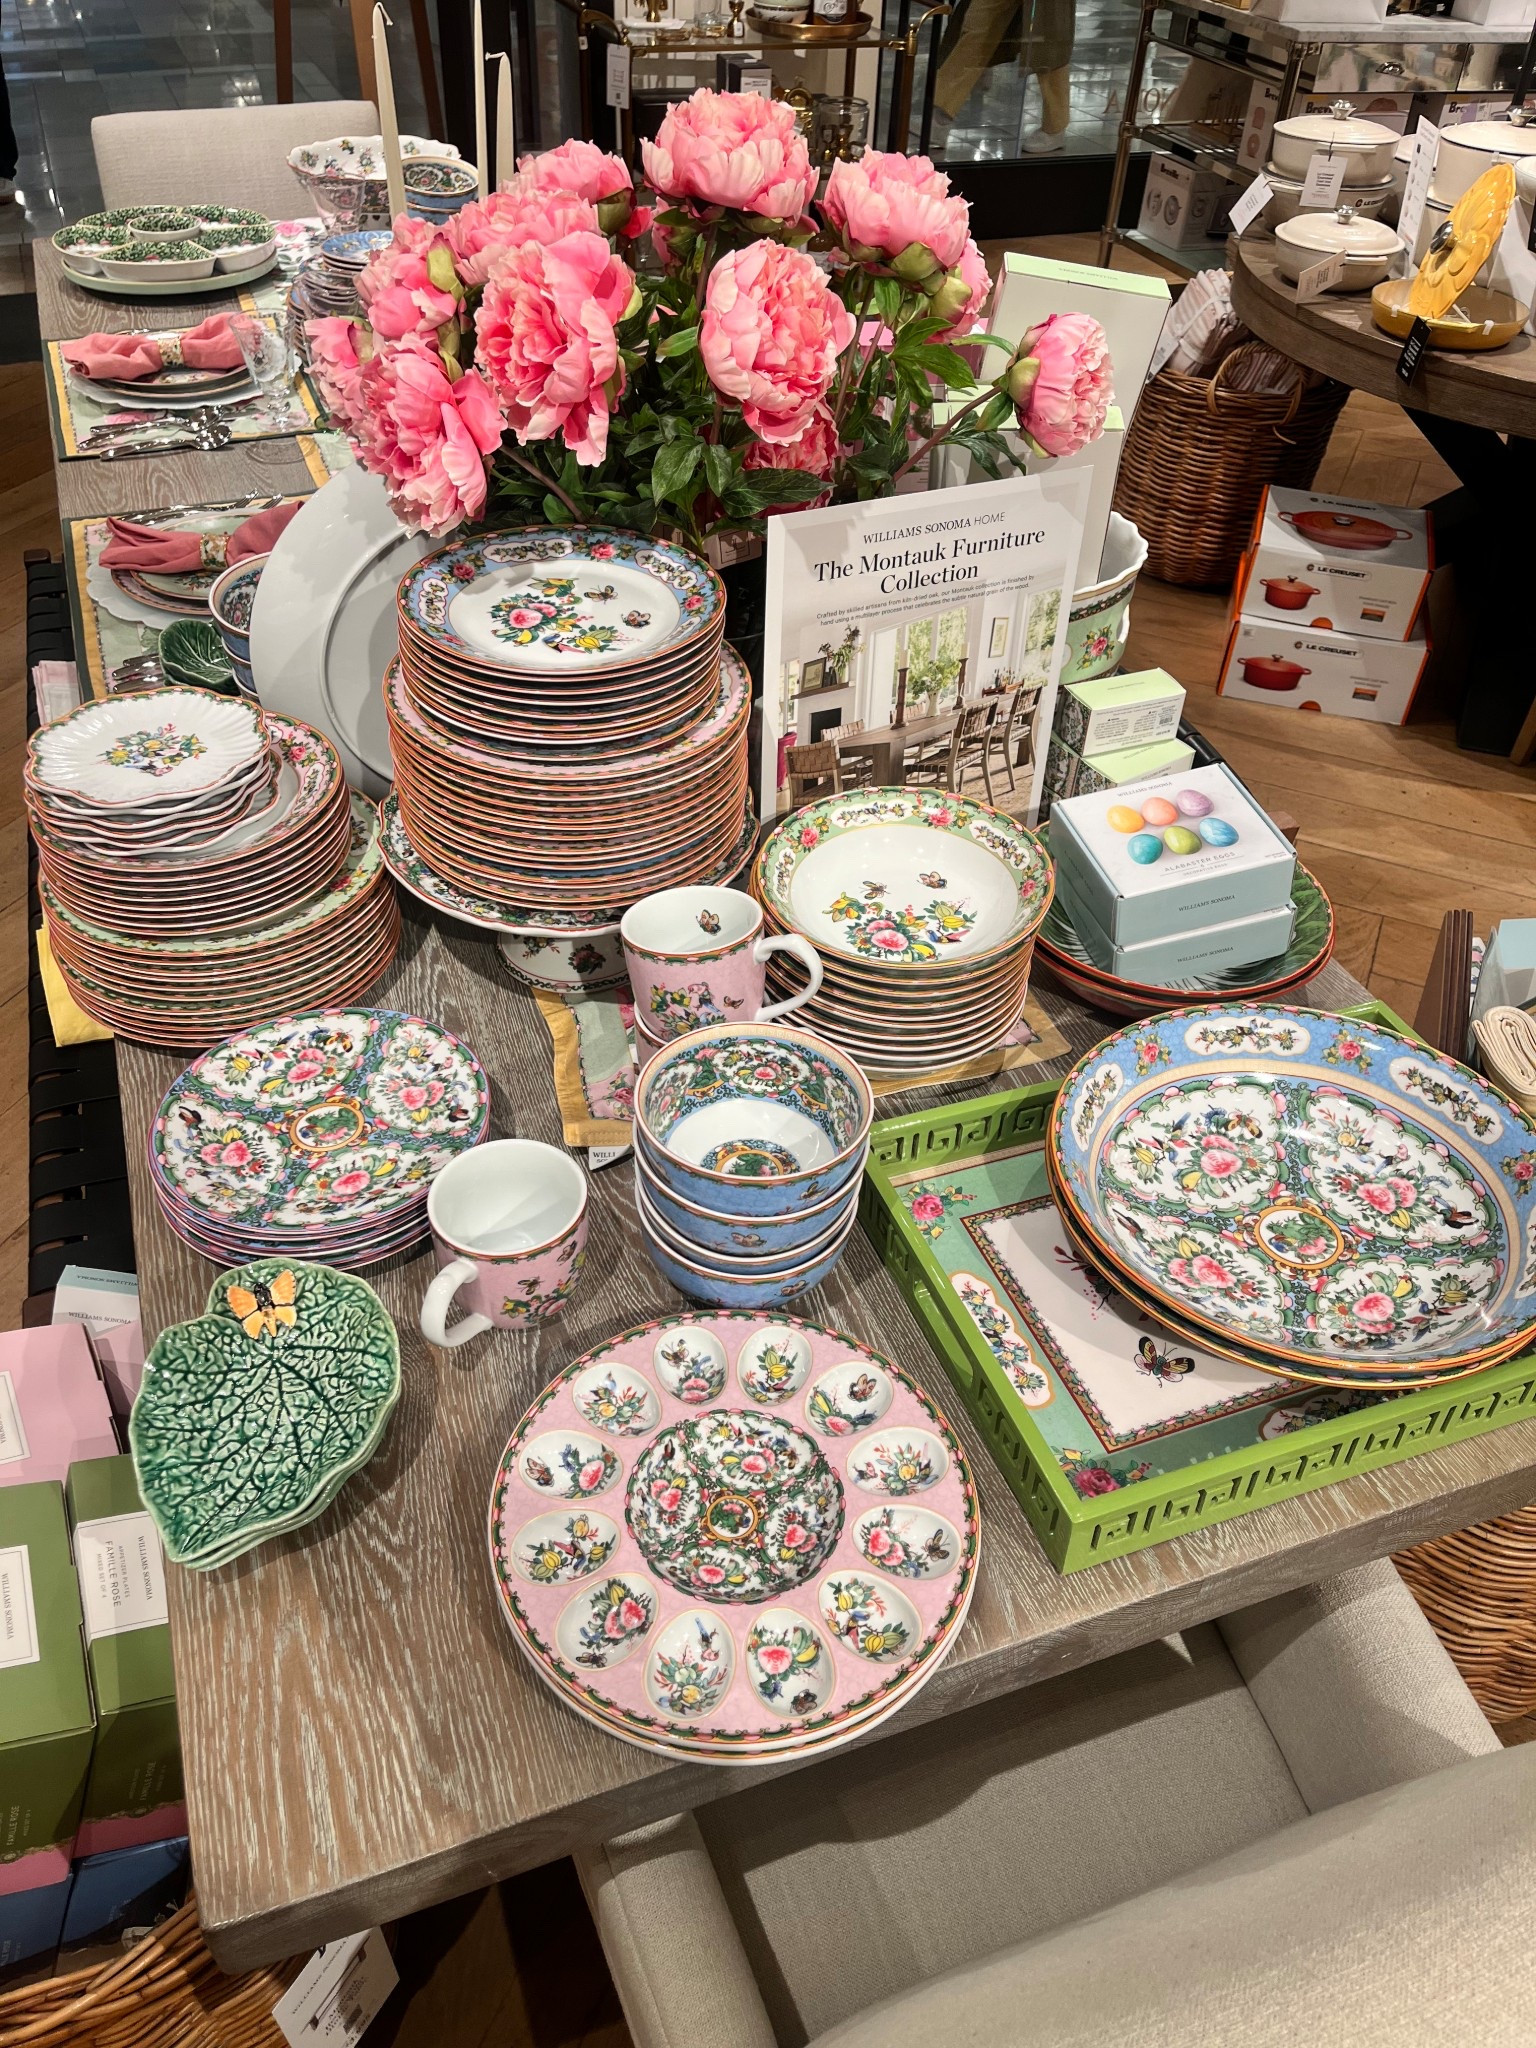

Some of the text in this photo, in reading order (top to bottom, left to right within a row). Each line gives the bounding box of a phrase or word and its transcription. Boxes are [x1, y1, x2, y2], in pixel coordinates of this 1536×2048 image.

[863, 512, 1006, 544] WILLIAMS SONOMA HOME
[814, 530, 1045, 582] The Montauk Furniture
[880, 564, 979, 594] Collection
[1329, 567, 1367, 579] CREUSET
[816, 609, 838, 620] Crafted
[838, 607, 846, 616] by
[888, 598, 901, 607] from
[951, 585, 974, 595] Montauk
[881, 606, 902, 616] process
[903, 603, 914, 611] that
[1318, 645, 1358, 657] CREUSET
[1178, 894, 1236, 912] WILLIAMS SONOMA
[68, 1311, 132, 1325] WILLIAMS SONOMA
[105, 1540, 122, 1607] FAMILLE ROSE
[118, 1545, 130, 1598] APPETIZER PLATES
[138, 1535, 153, 1601] WILLIAMS SONOMA
[1, 1573, 14, 1640] WILLIAMS SONOMA
